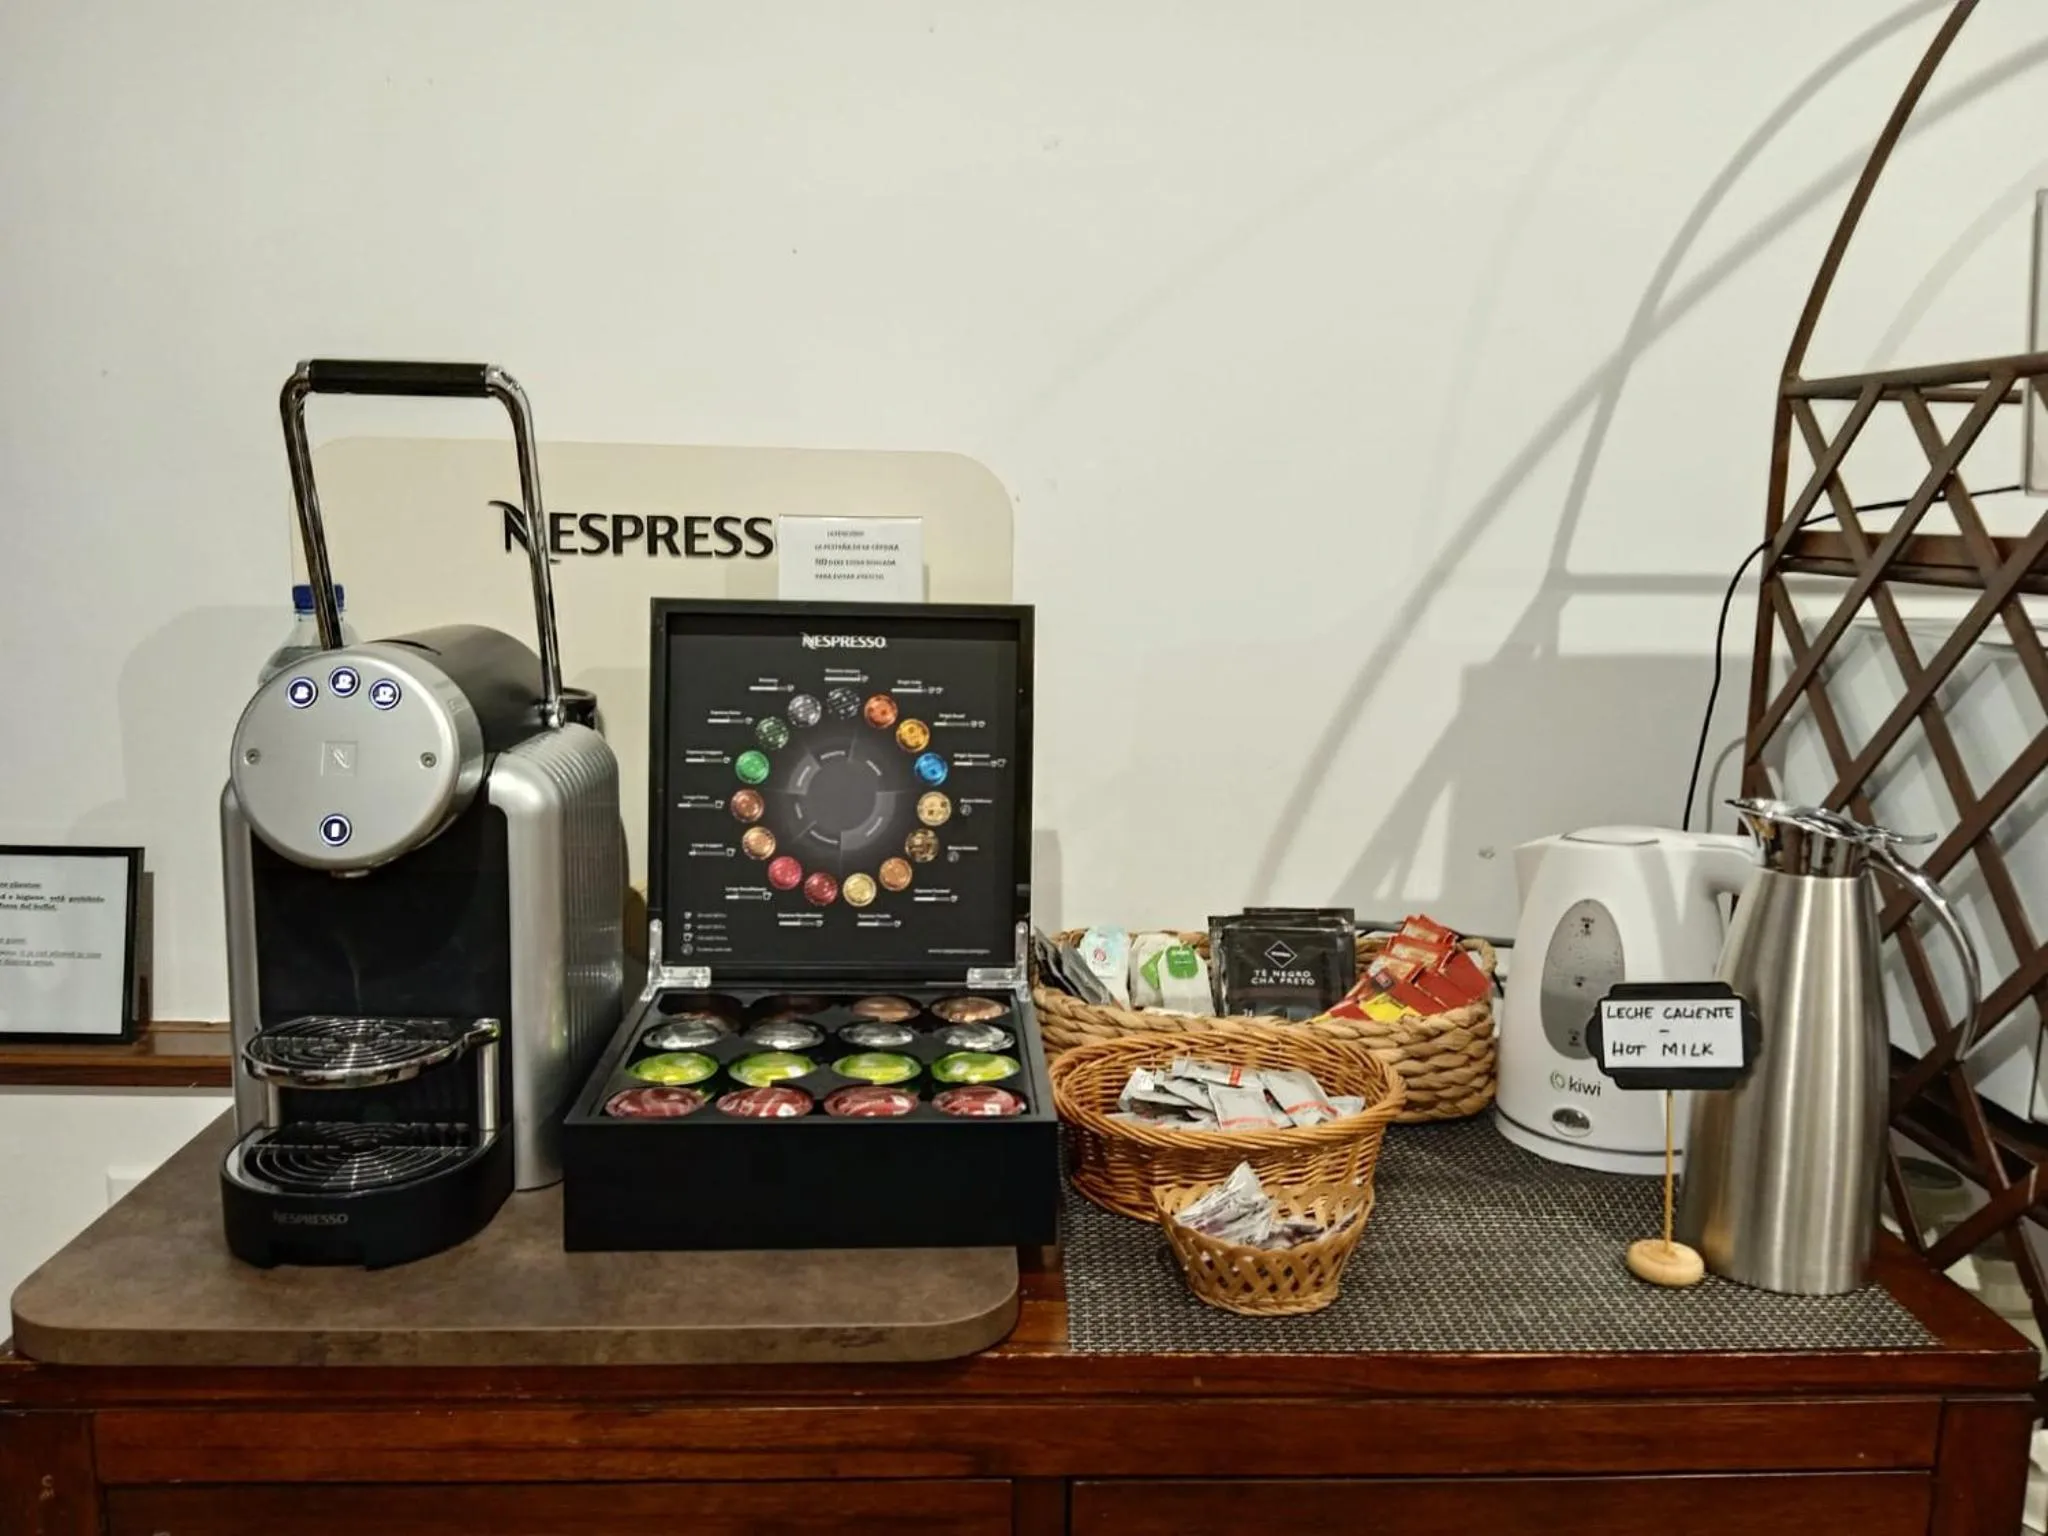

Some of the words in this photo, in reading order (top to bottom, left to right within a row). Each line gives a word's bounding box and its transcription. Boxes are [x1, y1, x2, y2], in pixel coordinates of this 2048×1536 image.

[488, 500, 777, 564] NESPRESS
[802, 633, 887, 649] NESPRESSO
[1272, 970, 1312, 978] NEGRO
[1279, 977, 1315, 986] PRETO
[1606, 1006, 1654, 1020] LECHE
[1663, 1005, 1735, 1020] CALIENTE
[1612, 1041, 1647, 1057] HOT
[1662, 1042, 1714, 1057] MILK
[1568, 1075, 1602, 1096] kiwi
